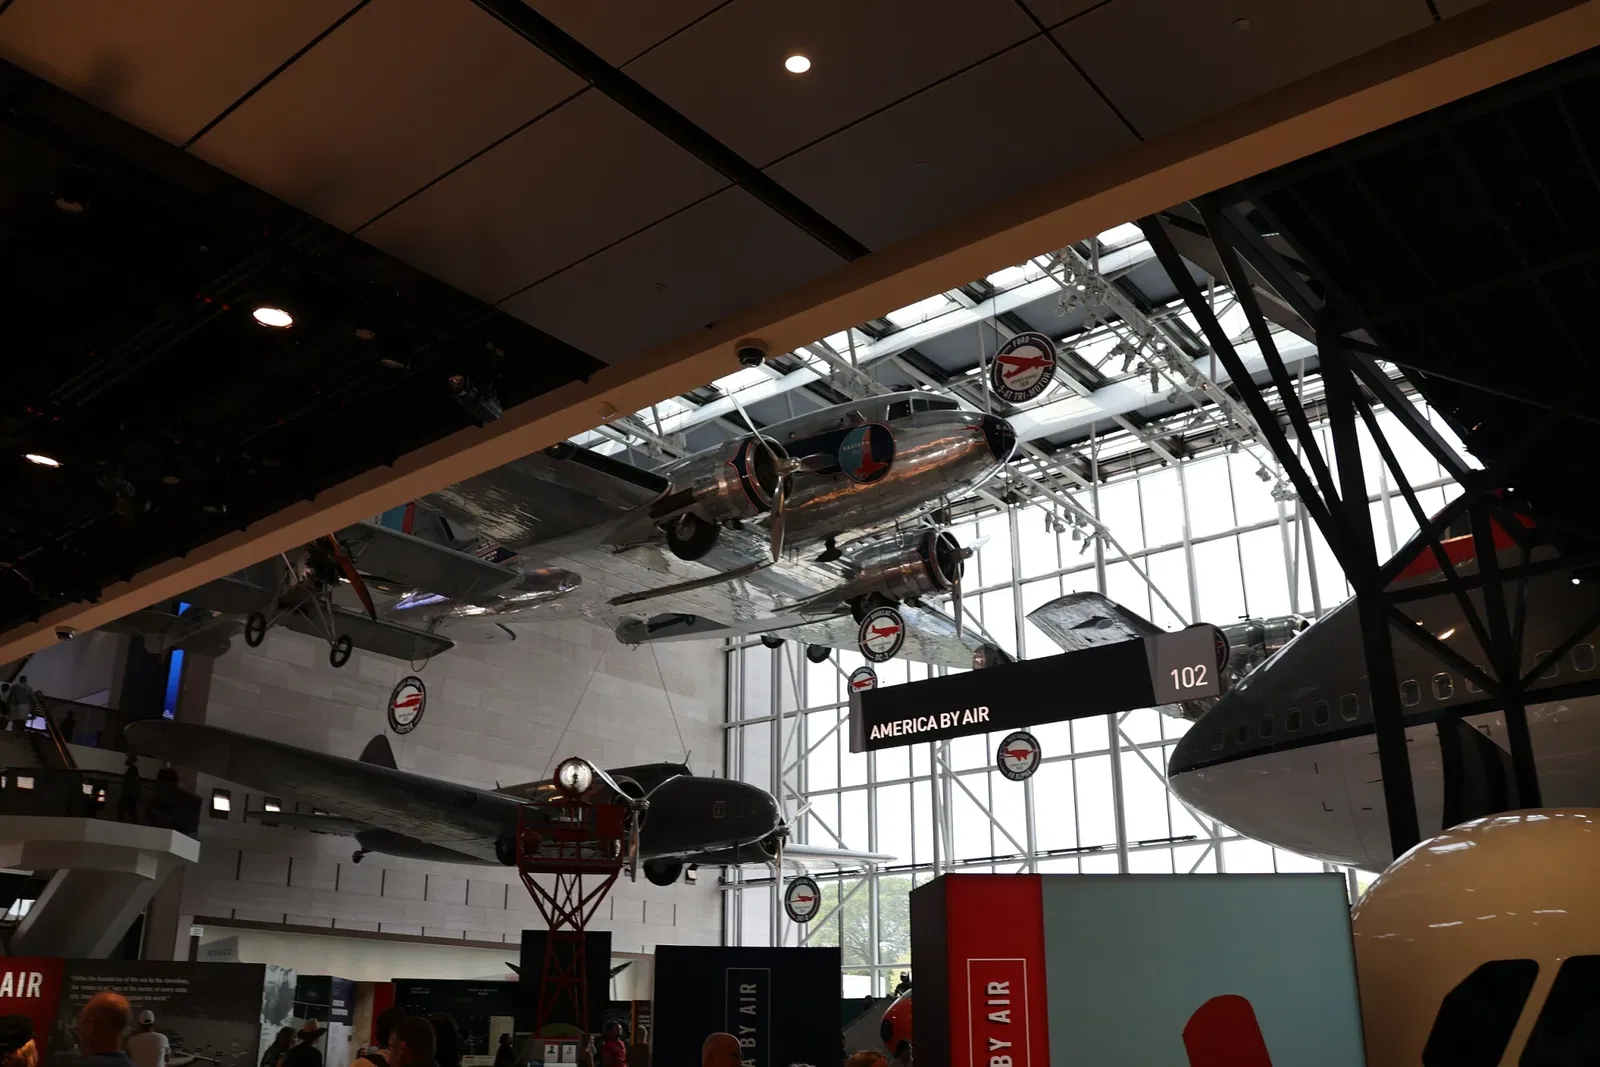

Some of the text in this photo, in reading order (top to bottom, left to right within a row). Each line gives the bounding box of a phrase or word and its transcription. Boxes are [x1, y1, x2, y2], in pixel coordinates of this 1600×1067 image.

[1012, 336, 1030, 348] FORD
[1014, 371, 1053, 401] TRI-MOTOR
[1171, 664, 1209, 690] 102
[869, 706, 991, 741] AMERICA BY AIR
[0, 971, 43, 998] AIR
[738, 983, 757, 1016] AIR
[738, 1023, 757, 1048] BY
[986, 980, 1013, 1067] BY AIR
